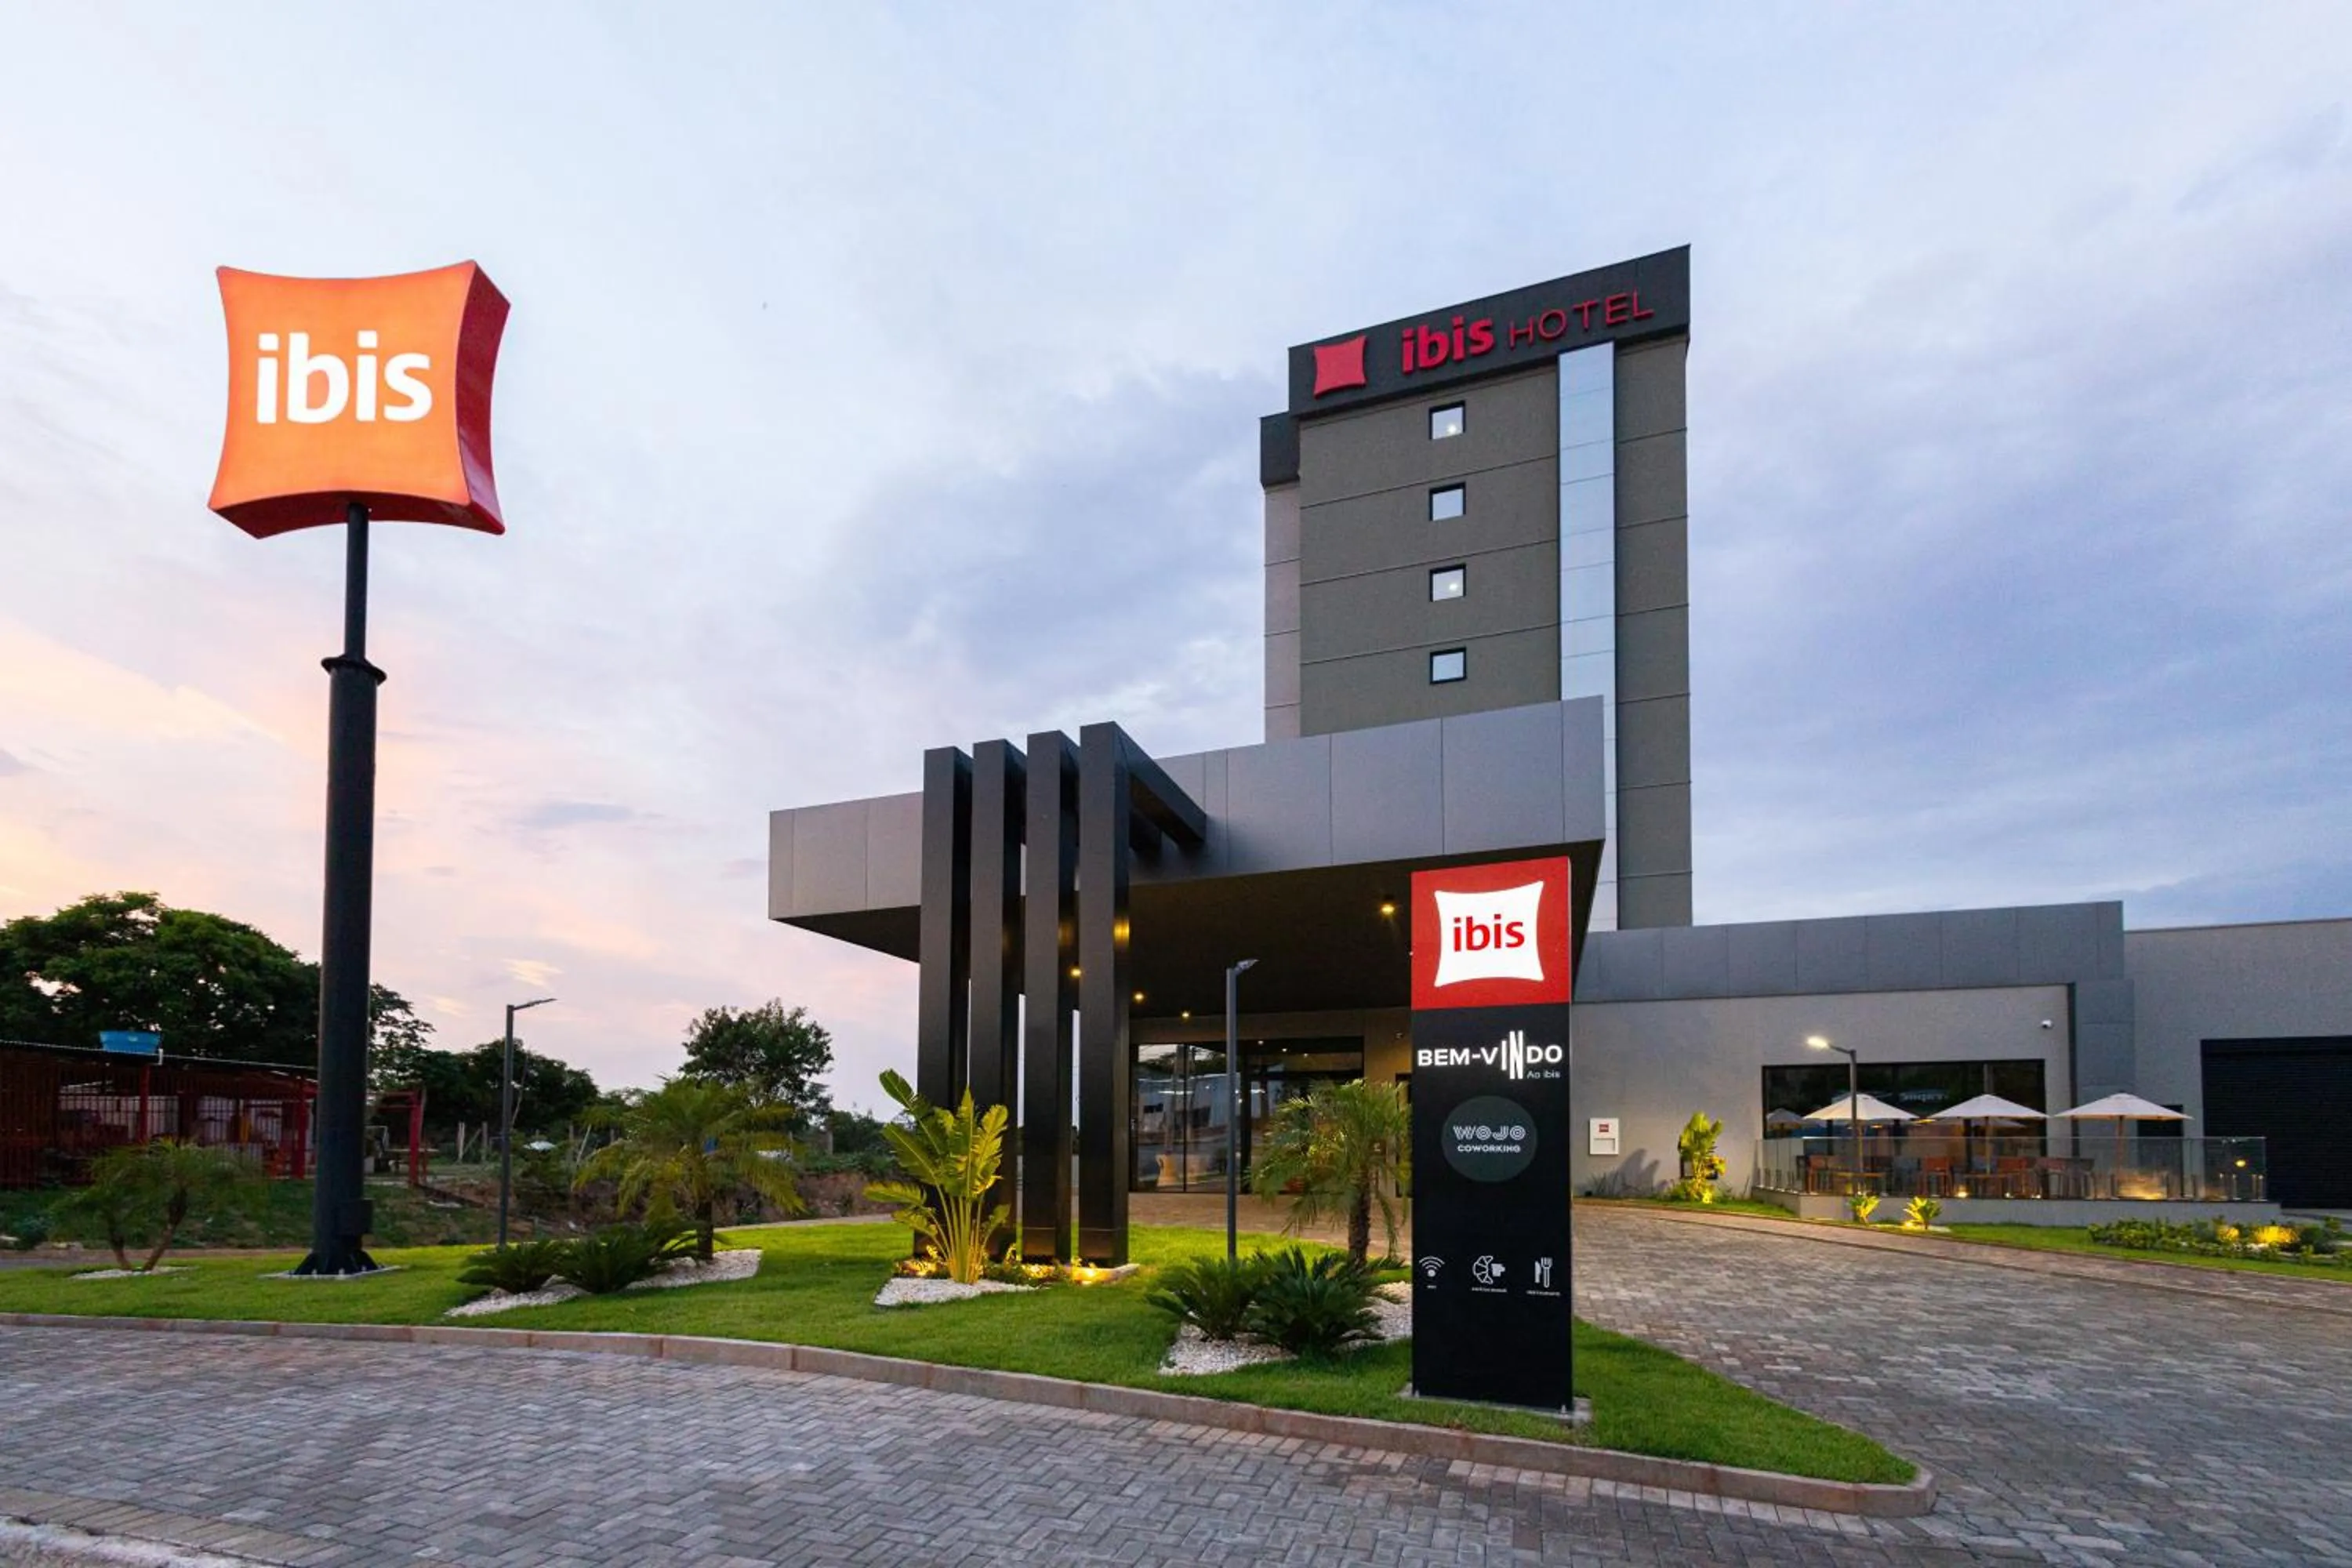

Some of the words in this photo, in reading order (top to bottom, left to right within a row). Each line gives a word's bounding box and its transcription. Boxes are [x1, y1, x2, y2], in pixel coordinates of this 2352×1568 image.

[1402, 315, 1495, 375] ibis
[1510, 287, 1655, 350] HOTEL
[256, 330, 433, 423] ibis
[1454, 914, 1525, 952] ibis
[1417, 1029, 1563, 1080] BEM-VINDO
[1453, 1125, 1526, 1141] WOJO
